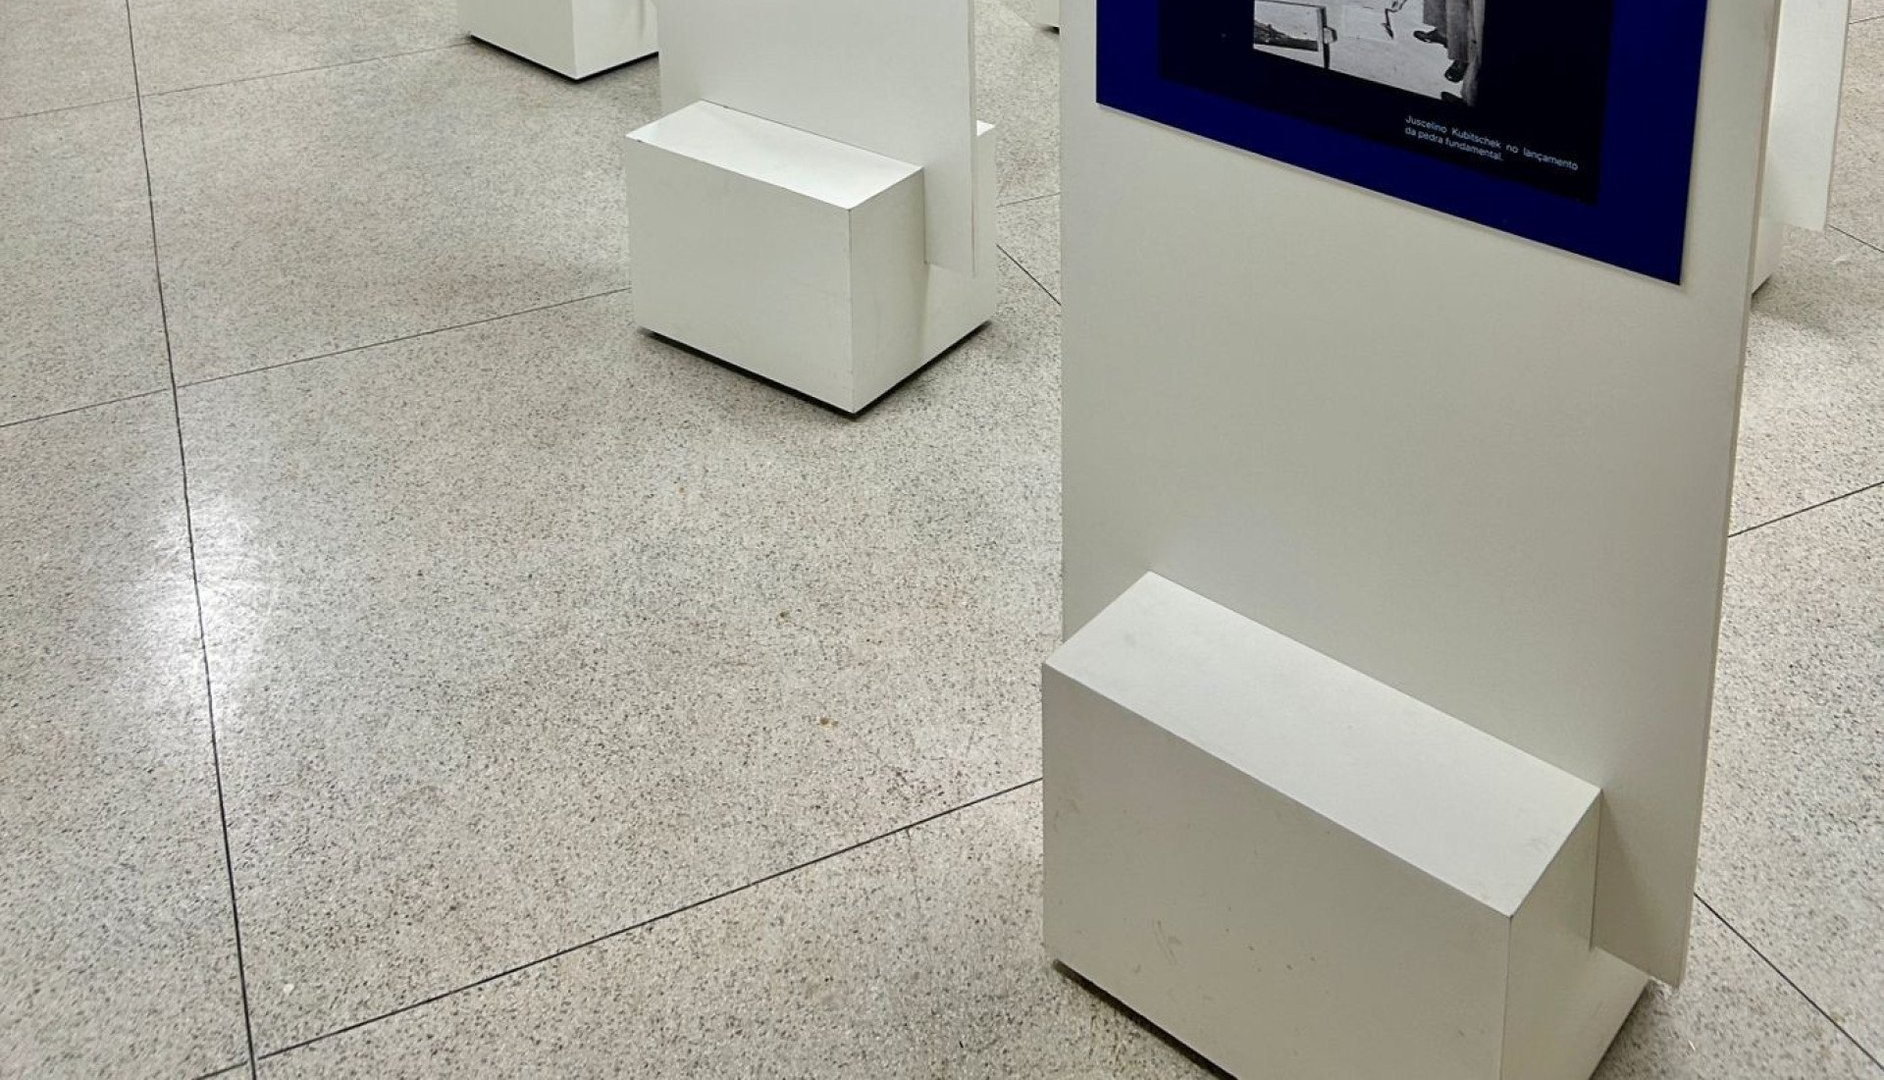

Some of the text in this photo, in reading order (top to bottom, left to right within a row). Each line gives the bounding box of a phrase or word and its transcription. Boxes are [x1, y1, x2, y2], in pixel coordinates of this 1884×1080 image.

[1405, 115, 1578, 170] Juscelino Kubitschek no lançamento
[1405, 127, 1502, 160] da pedra fundamental.
